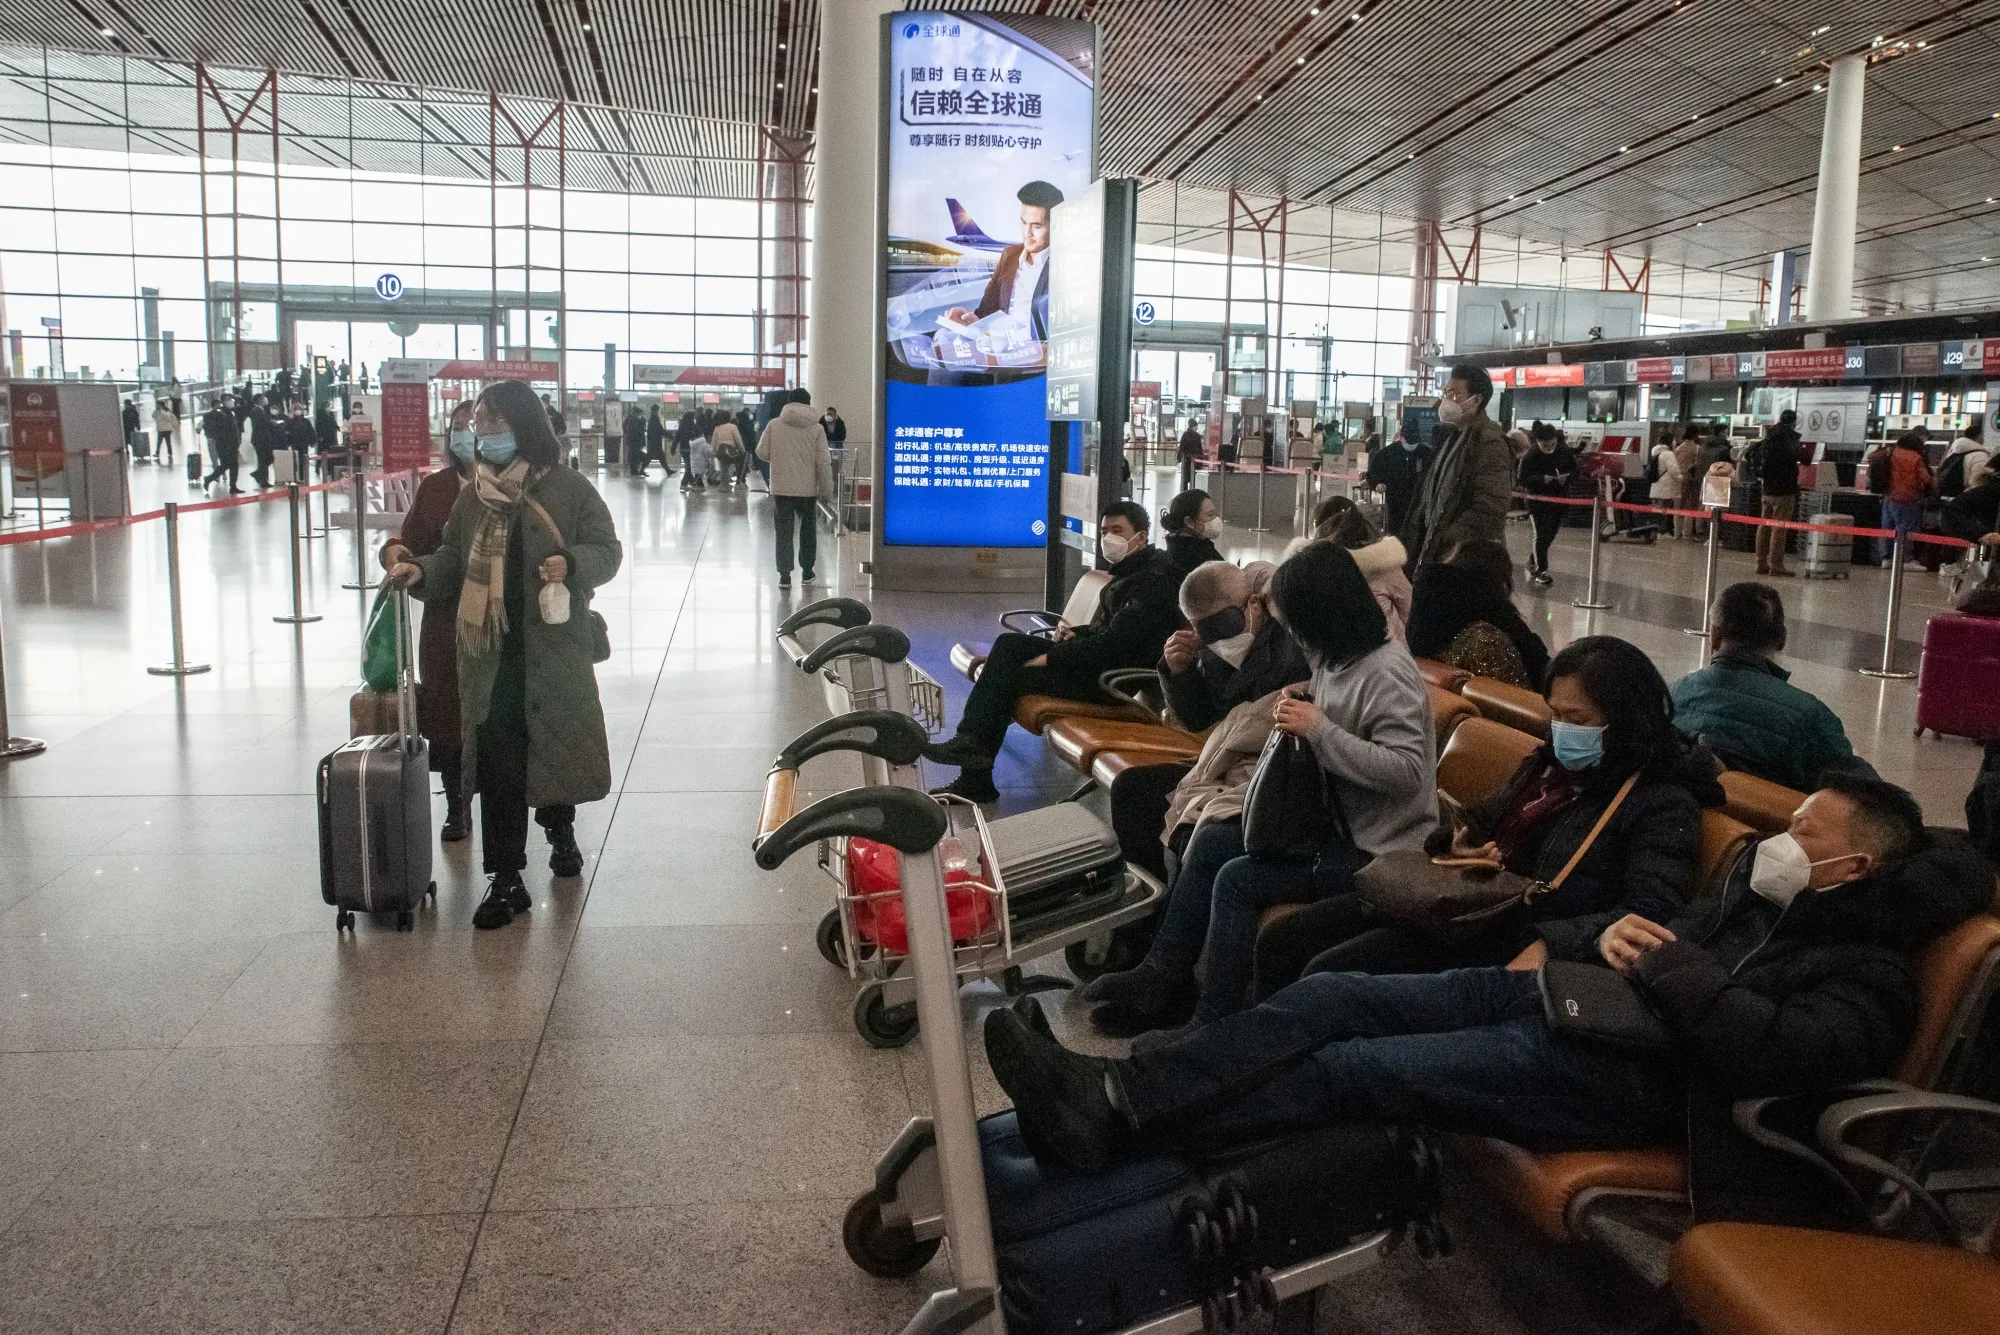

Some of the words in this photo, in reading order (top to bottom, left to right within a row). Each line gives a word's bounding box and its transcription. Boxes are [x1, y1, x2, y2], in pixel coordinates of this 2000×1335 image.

[922, 24, 961, 38] 全球通
[911, 67, 944, 82] 随时
[953, 67, 1022, 84] 自在从容
[911, 89, 1042, 119] 信赖全球通
[909, 134, 961, 147] 尊享随行
[965, 134, 1042, 150] 时刻贴心守护
[379, 276, 400, 296] 10
[1137, 303, 1153, 321] 12
[1845, 357, 1863, 369] J30
[1943, 352, 1963, 365] J29
[1672, 365, 1684, 376] J32
[1739, 361, 1752, 373] J31
[894, 427, 964, 438] 全球通客户尊享
